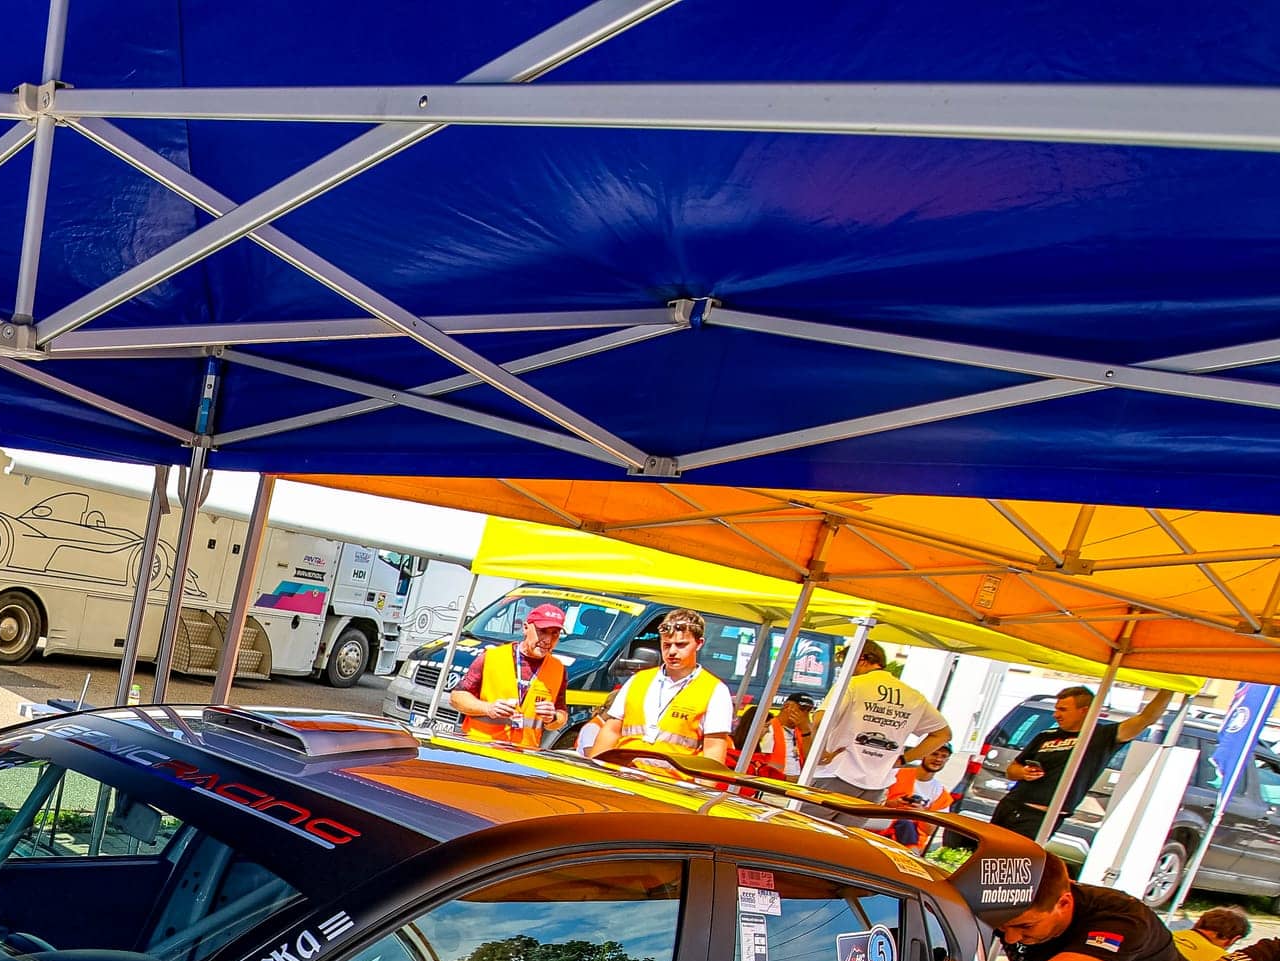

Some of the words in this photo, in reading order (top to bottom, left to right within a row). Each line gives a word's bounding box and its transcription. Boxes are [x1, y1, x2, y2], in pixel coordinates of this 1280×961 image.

[352, 568, 367, 580] HDI
[671, 711, 689, 722] BK
[864, 701, 886, 714] What
[886, 706, 893, 716] is
[894, 709, 912, 720] your
[863, 714, 908, 730] emergency?
[981, 857, 1033, 886] FREAKS
[981, 885, 1034, 905] motorsport
